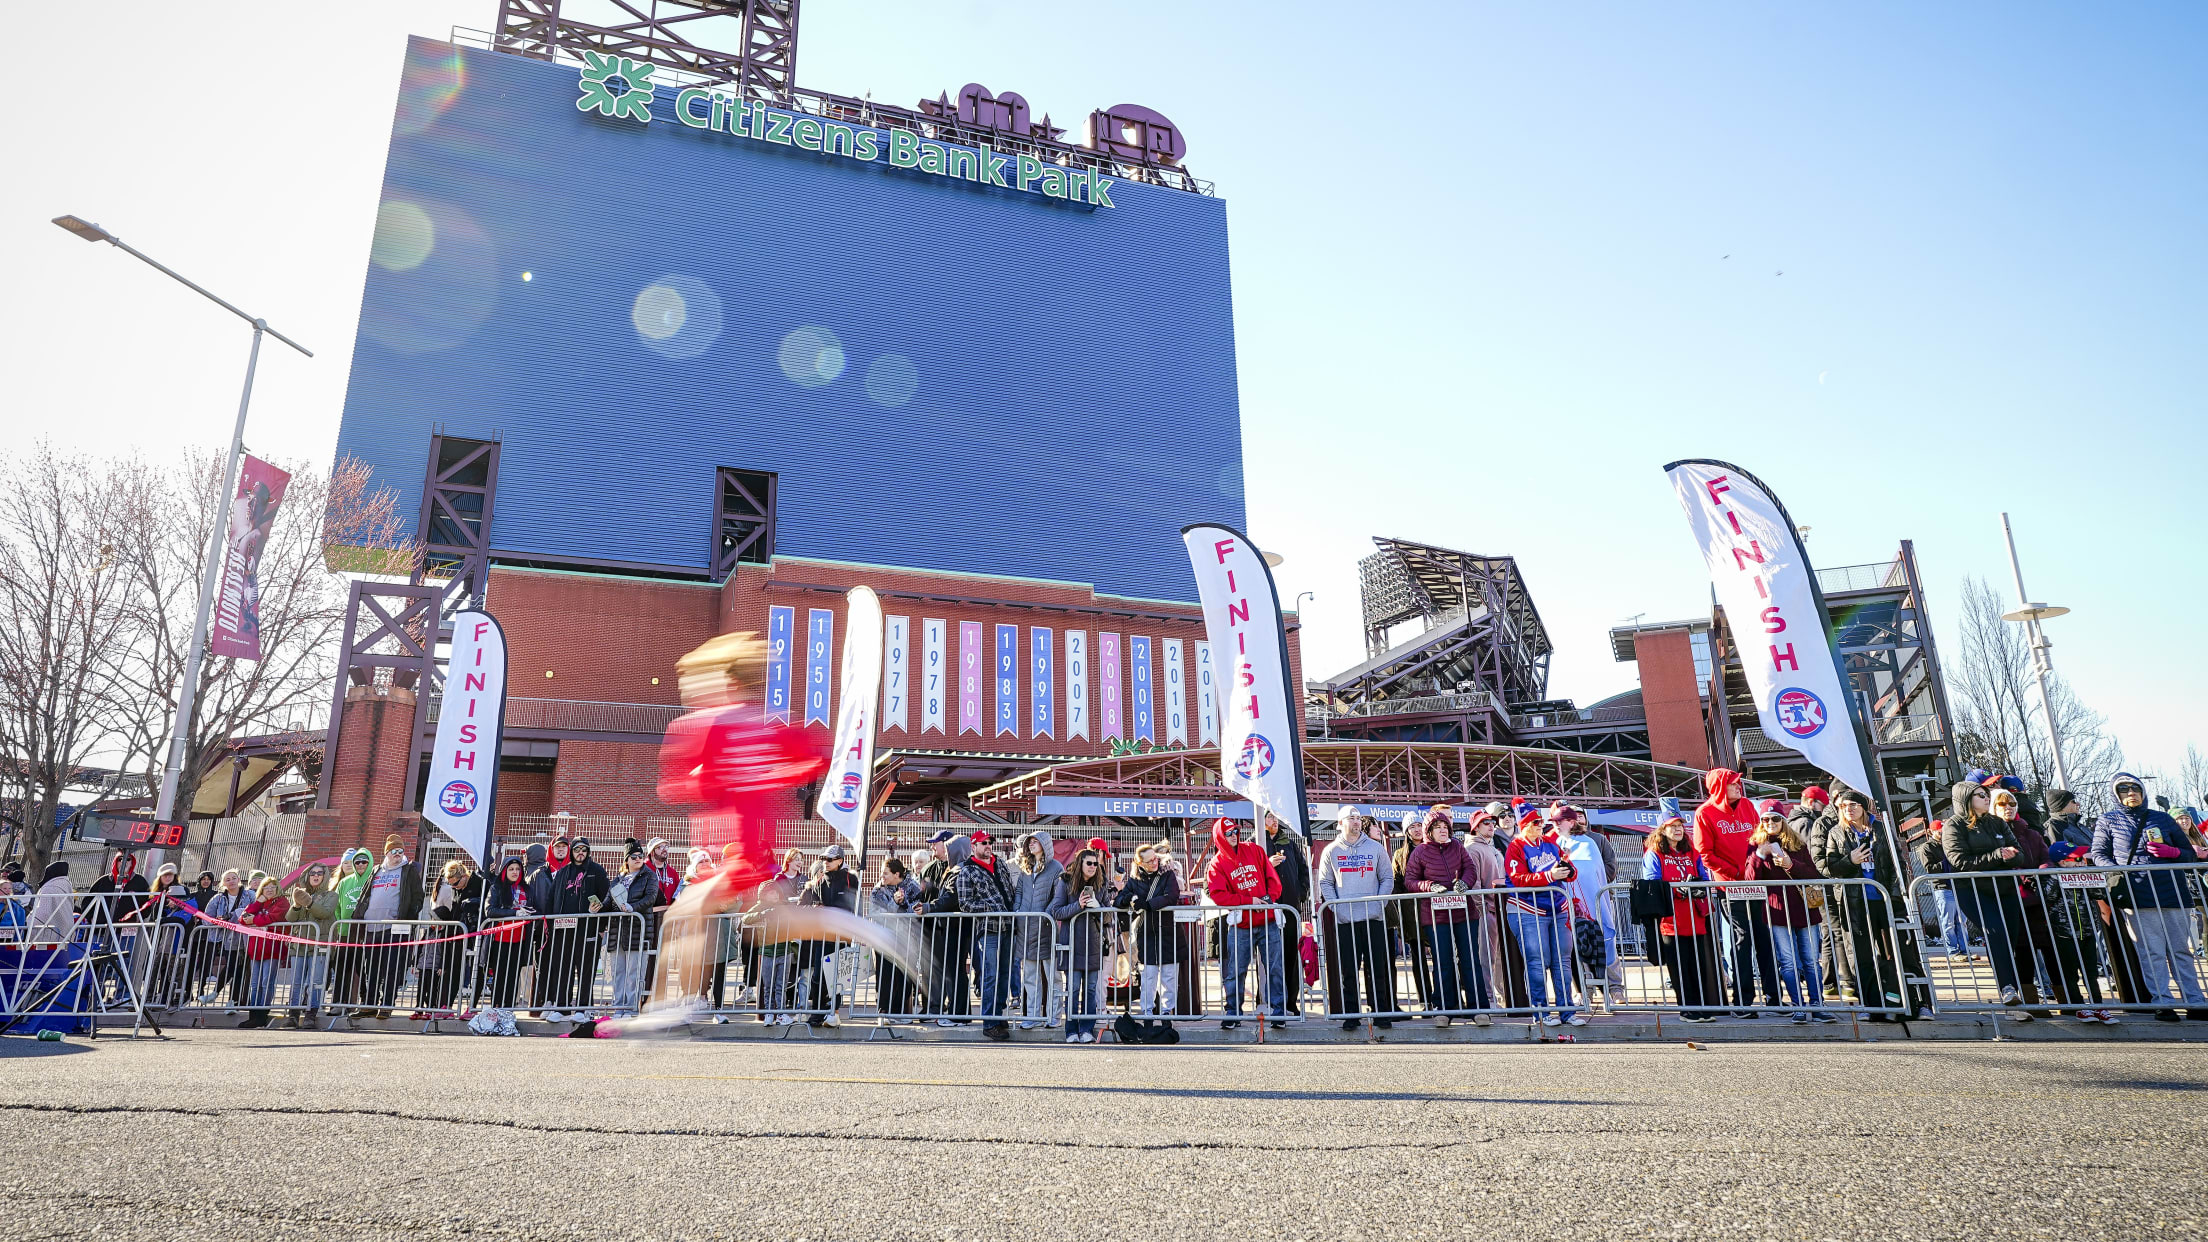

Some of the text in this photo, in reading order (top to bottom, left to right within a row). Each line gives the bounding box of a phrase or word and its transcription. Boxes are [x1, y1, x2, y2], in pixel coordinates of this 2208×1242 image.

[675, 87, 879, 161] Citizens
[888, 127, 1009, 188] Bank
[1016, 153, 1116, 209] Park
[218, 548, 246, 634] REALMUTO
[1704, 475, 1800, 672] FINISH
[773, 614, 785, 706] 1915
[813, 617, 825, 709] 1950
[891, 624, 901, 713] 1977
[929, 627, 938, 715] 1978
[1214, 538, 1260, 719] FINISH
[453, 621, 489, 771] FINISH
[966, 629, 975, 717] 1980
[1002, 632, 1011, 720] 1983
[1038, 635, 1047, 721] 1993
[1072, 637, 1081, 723] 2007
[1106, 640, 1116, 725] 2008
[1137, 643, 1147, 727] 2009
[1169, 646, 1180, 729] 2010
[1202, 648, 1211, 730] 2011
[1777, 700, 1825, 729] 5K
[440, 789, 476, 811] 5K
[1104, 801, 1225, 815] LEFT FIELD GATE
[1369, 807, 1411, 819] Welcom
[1451, 809, 1470, 819] tizen
[1634, 812, 1658, 823] LEFT
[1337, 860, 1366, 868] SERIES
[1432, 896, 1465, 904] NATIONAL
[1727, 886, 1766, 894] NATIONAL
[2060, 873, 2105, 882] NATIONAL
